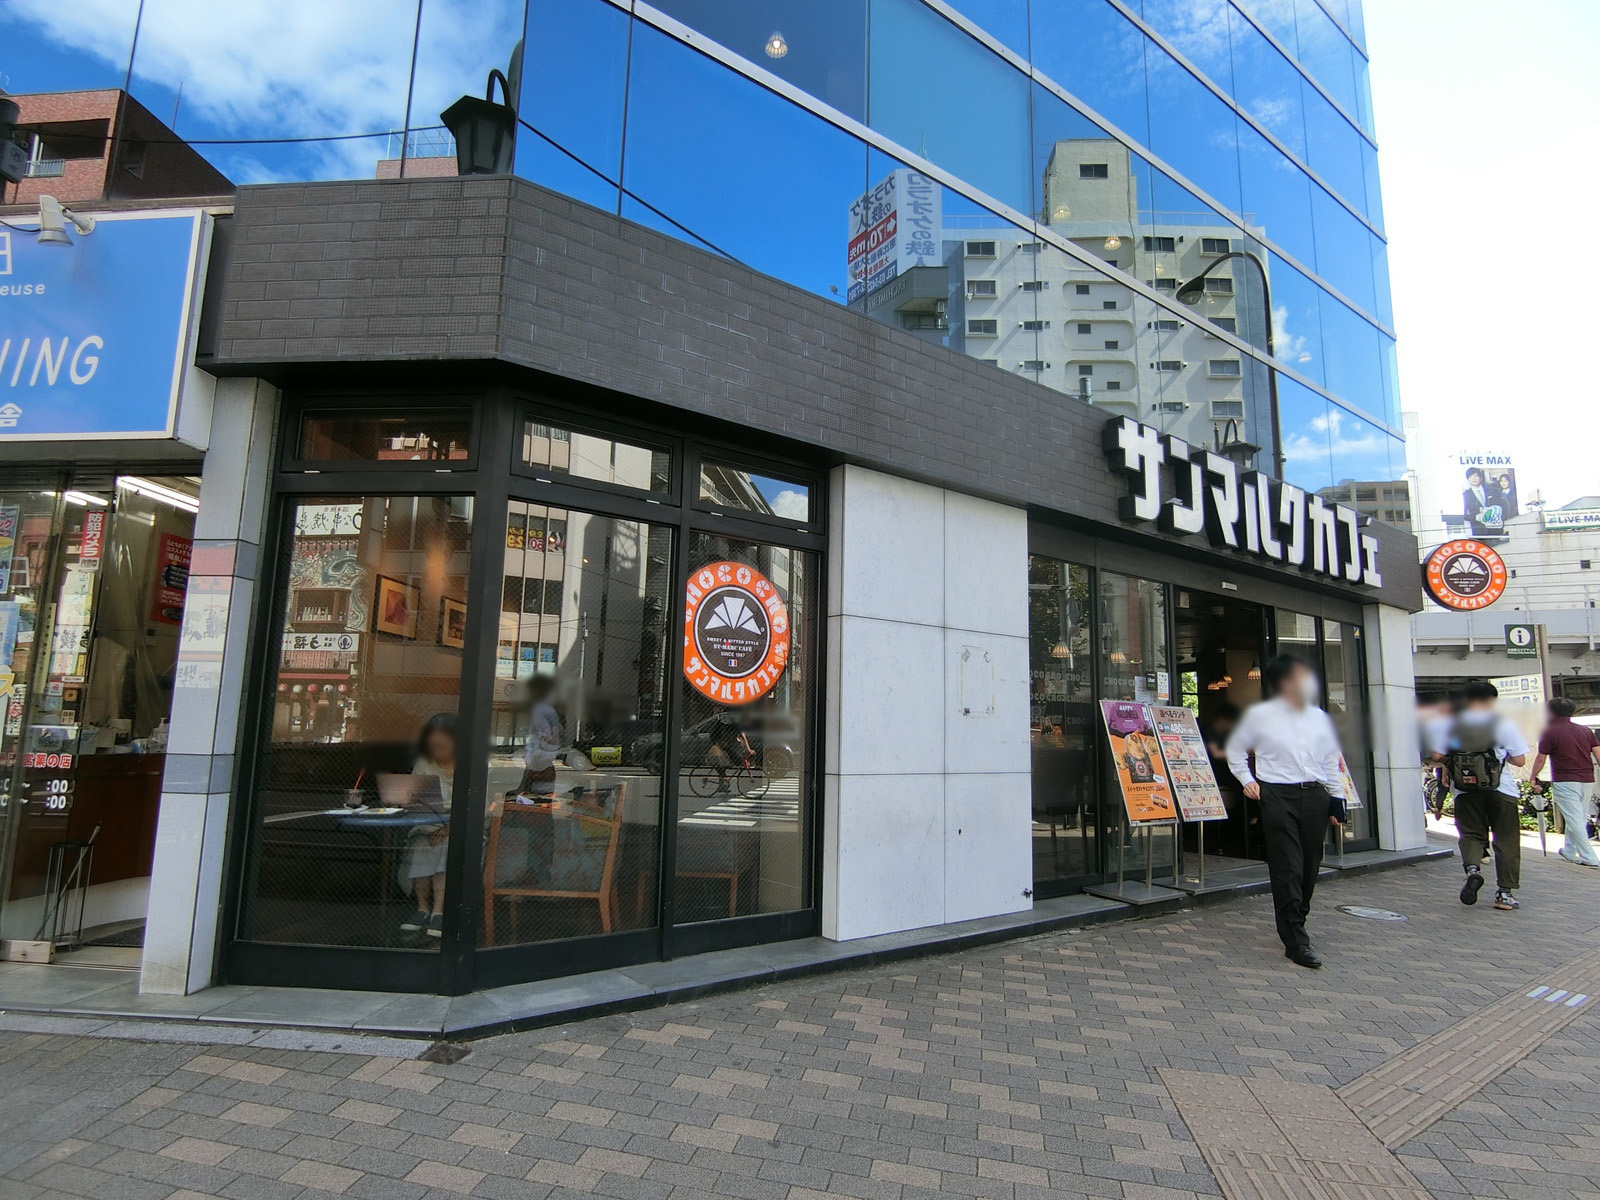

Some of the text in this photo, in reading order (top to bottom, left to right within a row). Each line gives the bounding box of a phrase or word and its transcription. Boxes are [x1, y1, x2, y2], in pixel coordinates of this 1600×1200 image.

[1486, 456, 1512, 465] MAX
[1115, 415, 1383, 588] サンマルクカフェ
[84, 512, 104, 556] 防犯カメラ
[1429, 542, 1503, 574] CHOCO CRO
[1438, 588, 1499, 608] サンマルクカフェ
[686, 656, 779, 700] サンマルクカフェ
